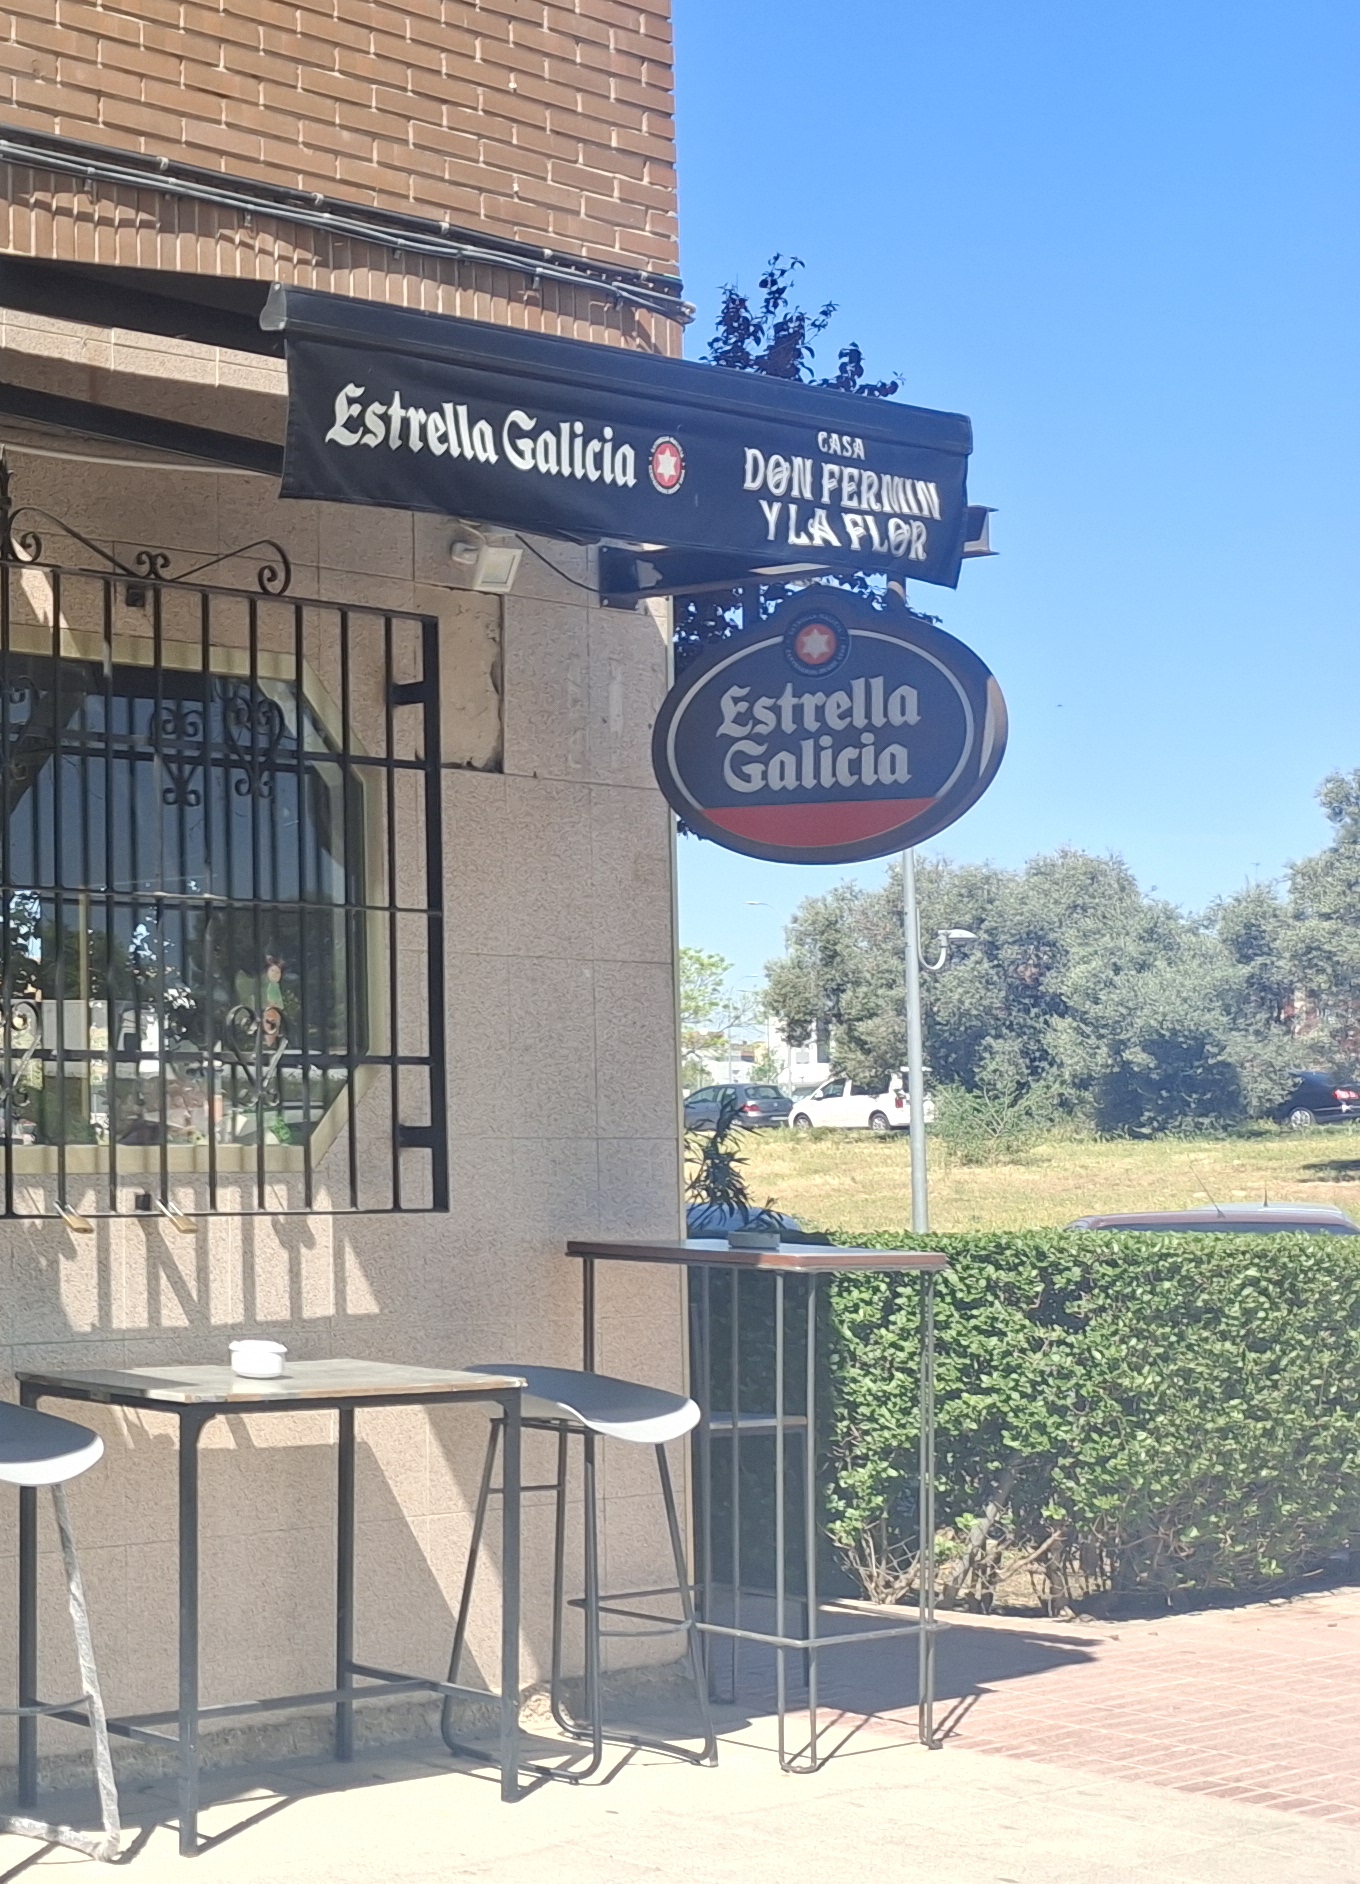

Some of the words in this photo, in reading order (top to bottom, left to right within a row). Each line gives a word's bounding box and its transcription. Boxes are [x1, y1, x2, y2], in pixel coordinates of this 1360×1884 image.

[325, 382, 499, 465] Estrella
[502, 409, 638, 488] Galicia
[817, 431, 866, 461] CASA
[743, 446, 814, 501] DON
[820, 462, 942, 521] FERMIN
[758, 499, 782, 541] Y
[787, 503, 842, 547] LA
[841, 512, 928, 561] FLOR
[715, 675, 923, 739] Estrella
[722, 731, 913, 793] Galicia
